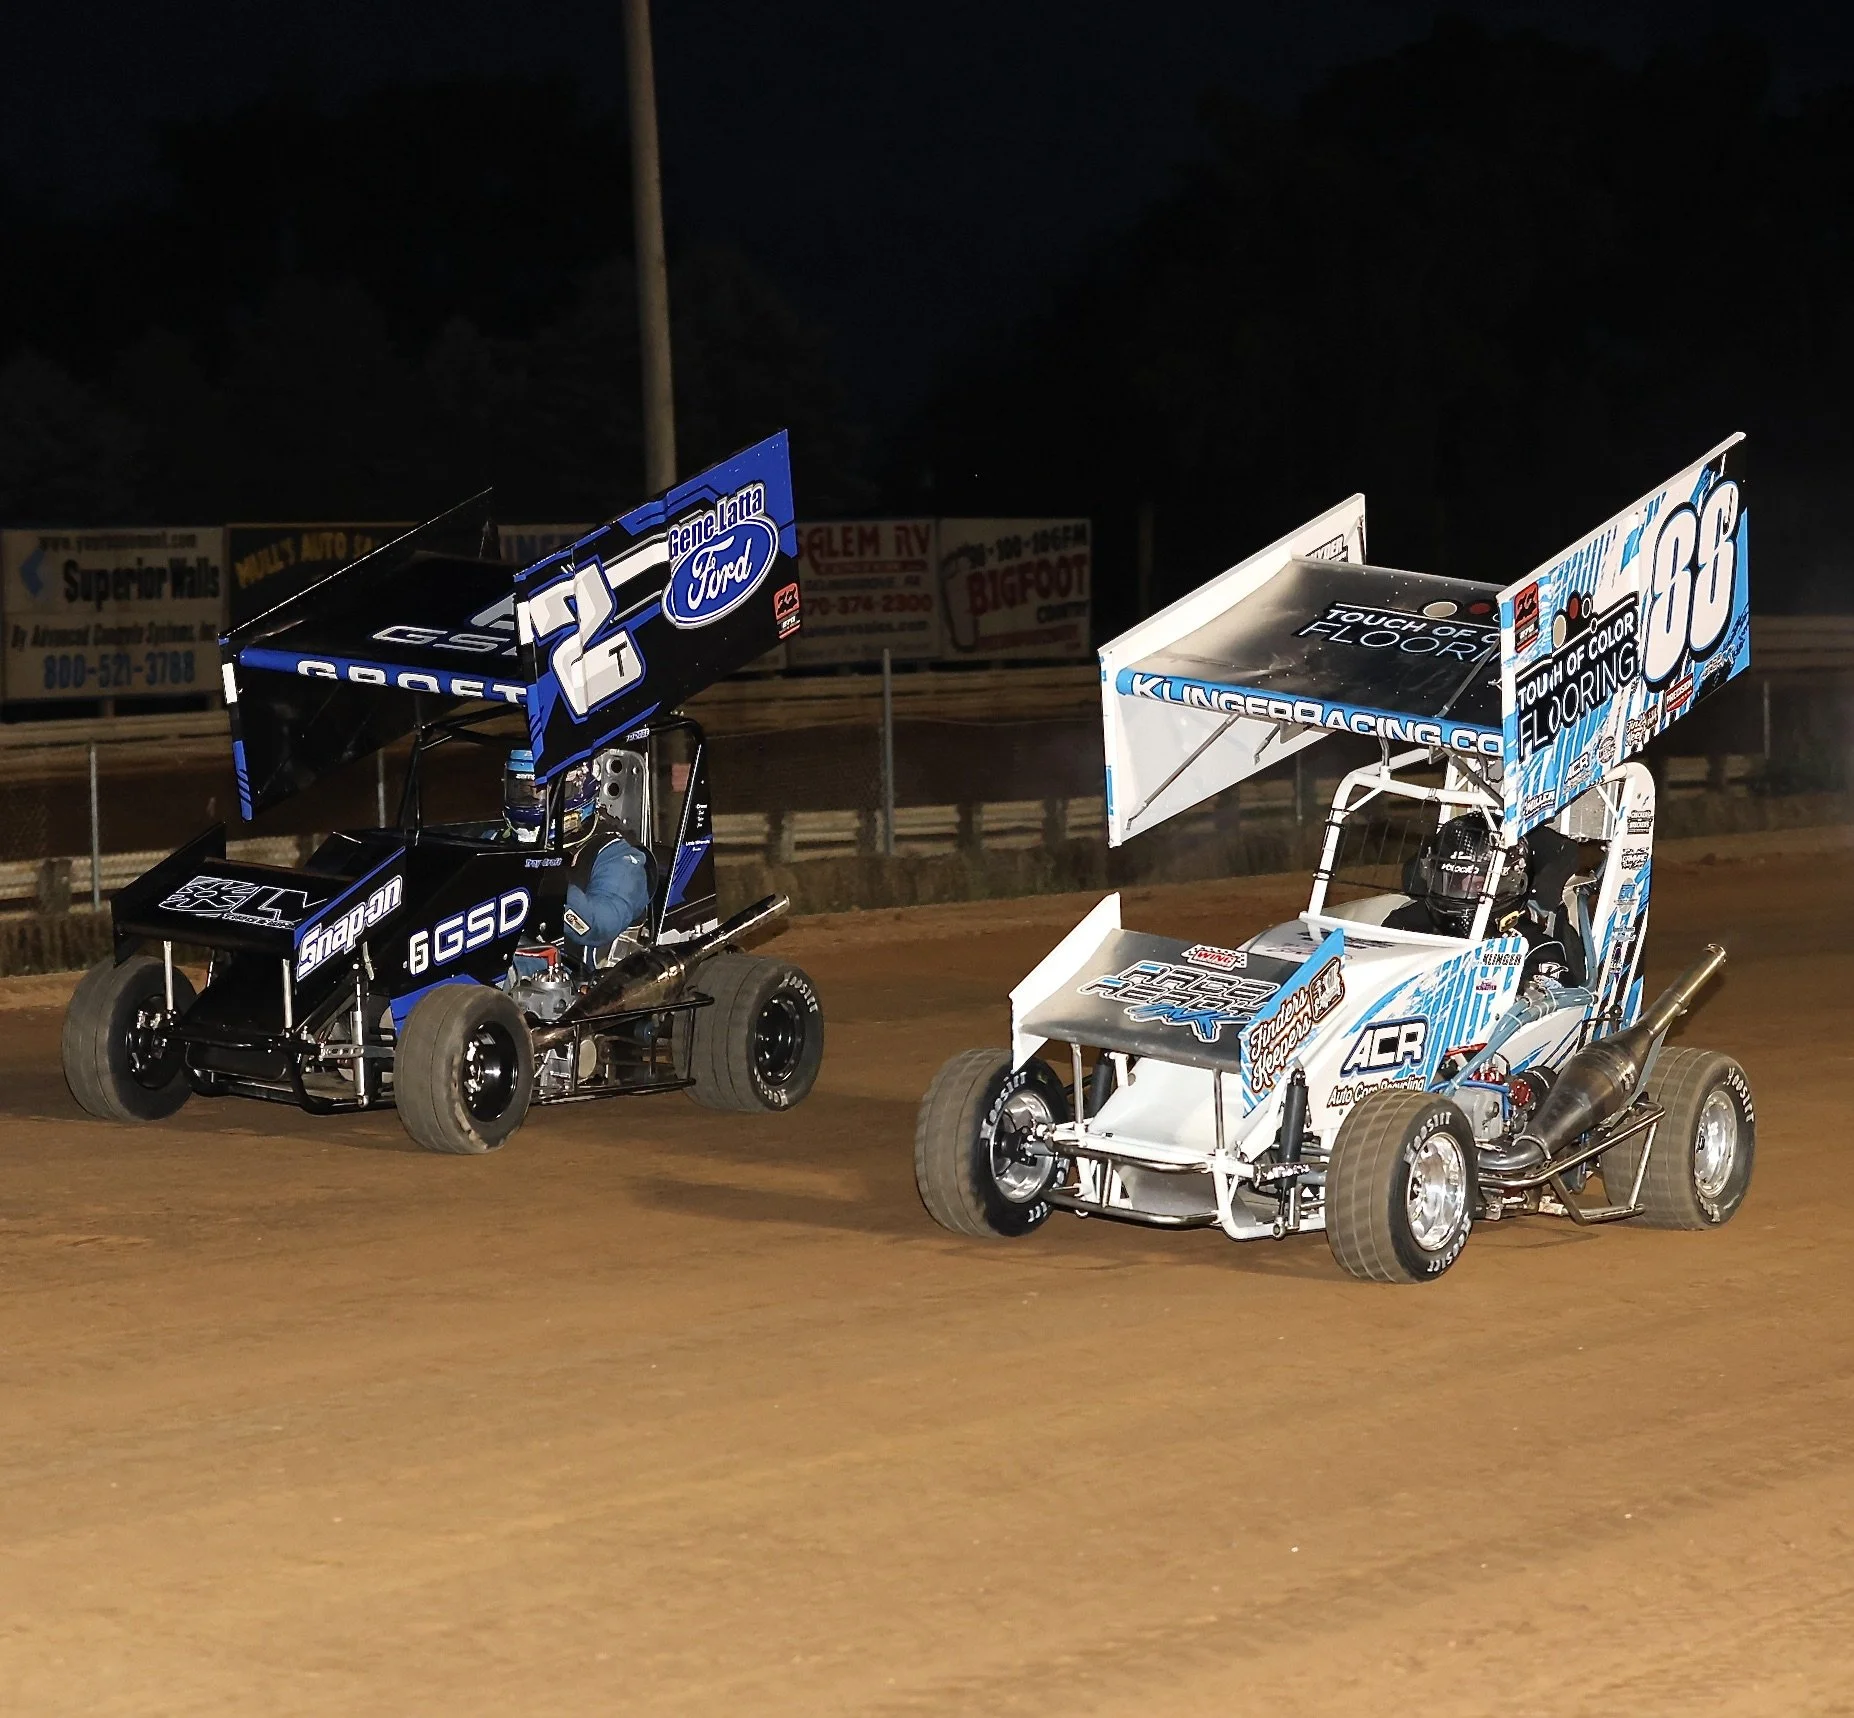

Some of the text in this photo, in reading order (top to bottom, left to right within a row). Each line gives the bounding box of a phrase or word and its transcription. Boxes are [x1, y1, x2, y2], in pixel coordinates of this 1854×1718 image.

[301, 532, 347, 563] AUTO
[668, 483, 765, 560] Gene Latta
[63, 557, 220, 611] Superior Walls
[686, 535, 753, 611] Ford
[966, 554, 1088, 616] BIGFOOT
[528, 563, 641, 716] 2
[1325, 609, 1428, 632] TOUCH
[1431, 626, 1478, 639] OF
[1566, 645, 1585, 676] OF
[1588, 611, 1635, 661] COLOR
[608, 641, 628, 677] T
[1131, 672, 1502, 759] KLINGERRACING.CO
[1519, 642, 1636, 758] FLOORING
[1565, 753, 1590, 784] ACR
[297, 875, 402, 981] Snap-on
[434, 890, 530, 964] GSD
[1119, 961, 1280, 1002] RACE
[1197, 950, 1234, 964] WING
[1482, 953, 1522, 966] KLINGER
[1078, 976, 1268, 1016] READY
[1250, 987, 1310, 1061] Finders
[1251, 1011, 1312, 1093] Keepers
[1340, 1017, 1428, 1074] ACR
[1326, 1085, 1352, 1108] Auto
